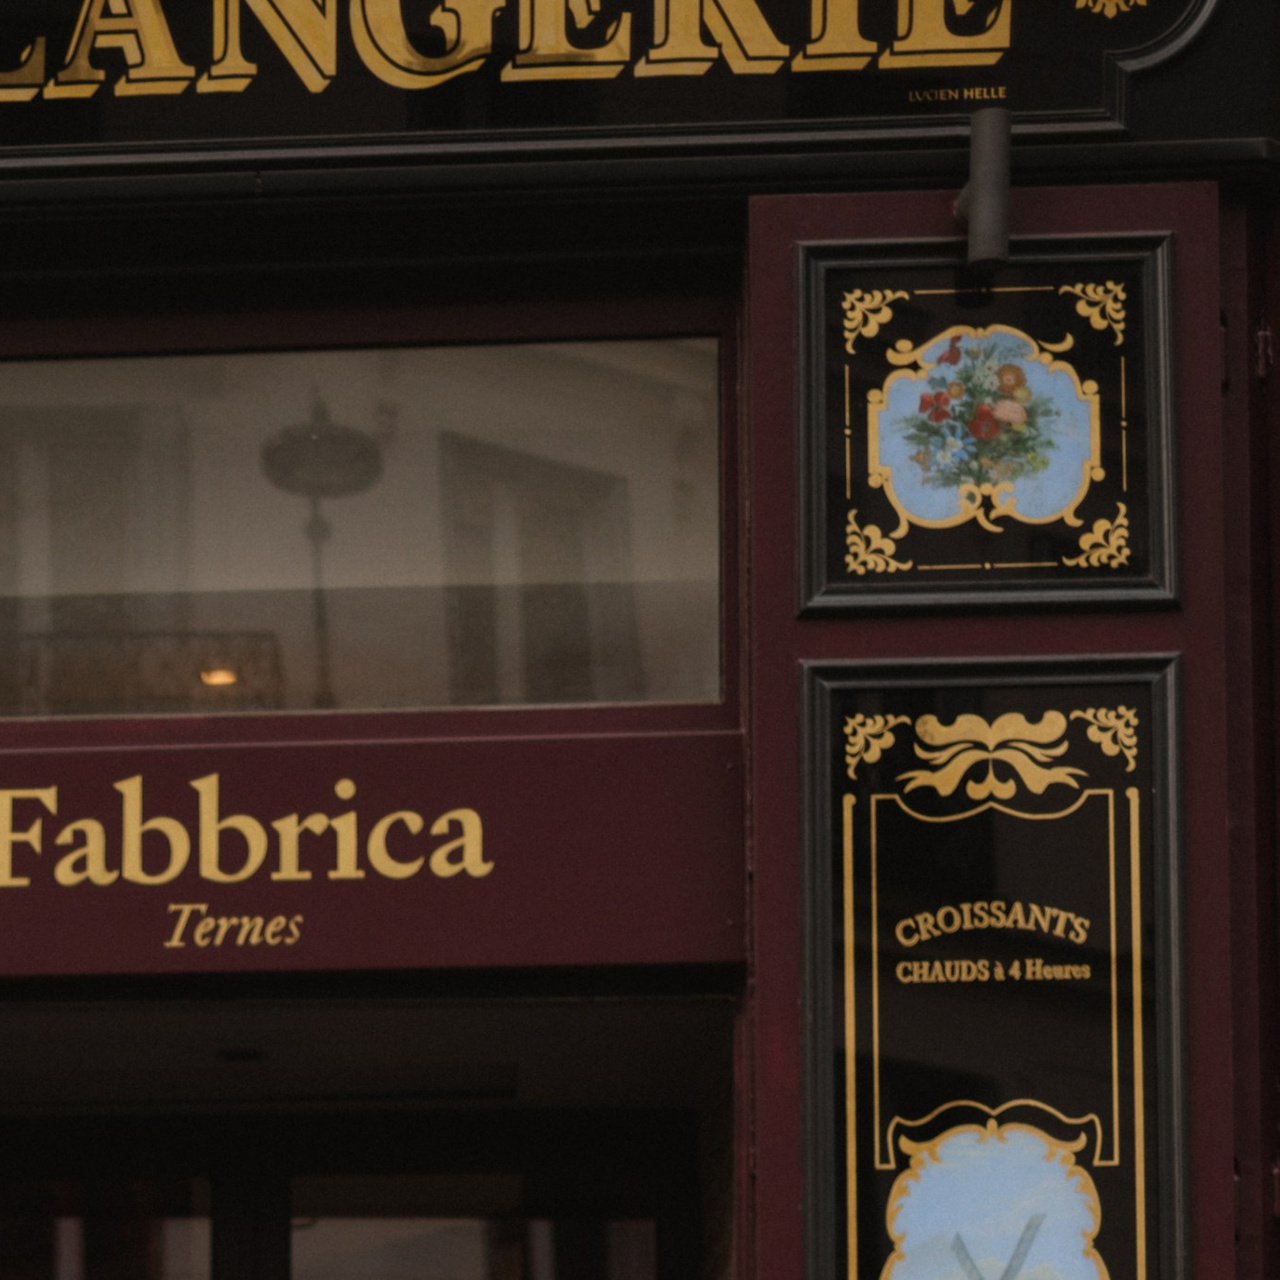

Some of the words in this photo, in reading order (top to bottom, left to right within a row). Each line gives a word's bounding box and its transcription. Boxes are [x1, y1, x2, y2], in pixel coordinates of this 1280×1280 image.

[963, 86, 1007, 100] HELLE
[163, 902, 304, 948] Ternes
[894, 900, 1091, 947] CROISSANTS
[895, 959, 990, 984] CHAUDS
[993, 960, 1005, 982] à
[1008, 959, 1021, 981] 4
[1024, 958, 1091, 981] Heures
